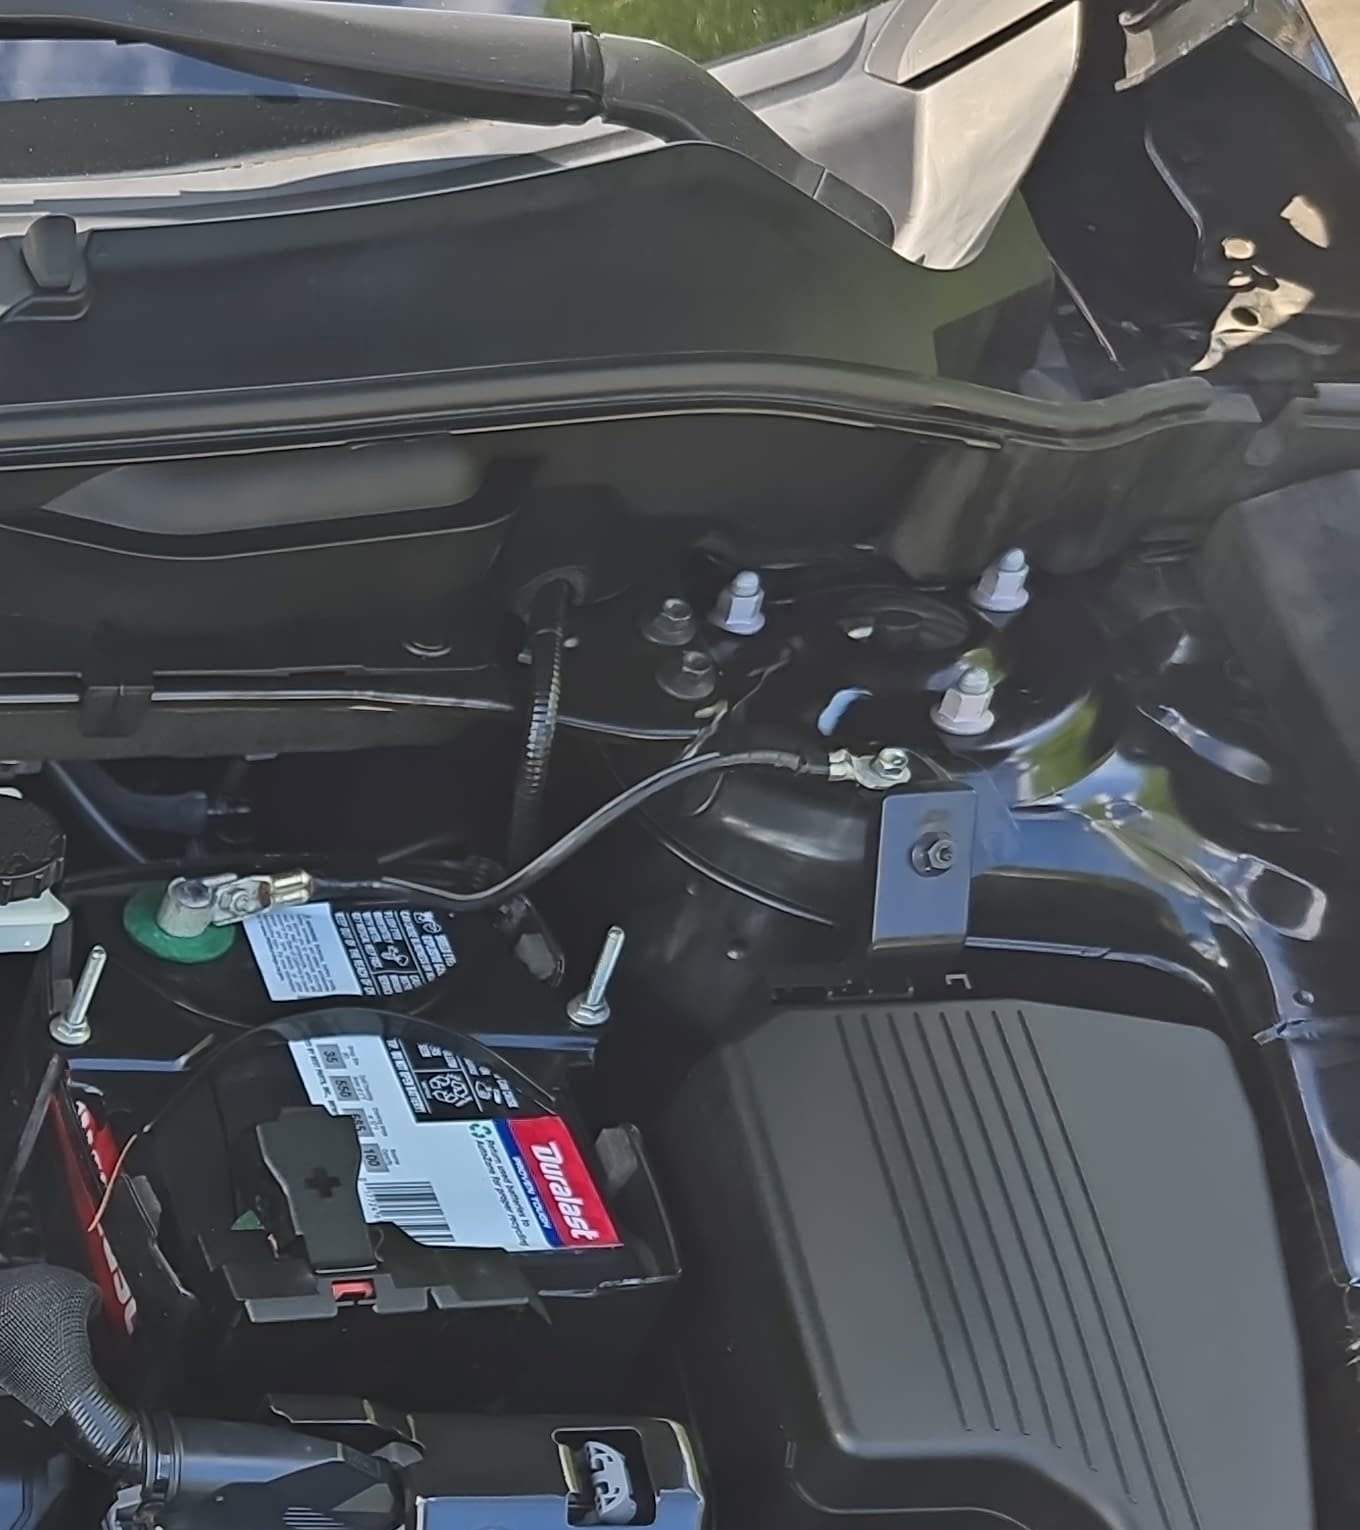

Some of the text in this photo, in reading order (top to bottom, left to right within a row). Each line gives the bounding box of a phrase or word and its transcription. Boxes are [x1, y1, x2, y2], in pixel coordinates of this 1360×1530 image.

[321, 1049, 340, 1063] 35
[332, 1078, 353, 1098] 550
[361, 1148, 382, 1167] 100
[474, 1139, 497, 1174] AutoZone
[484, 1139, 532, 1227] Return used batteries to
[489, 1175, 503, 1186] for
[510, 1155, 551, 1229] PROVEN TOUGH
[528, 1140, 600, 1241] Duralast
[493, 1187, 514, 1213] proper
